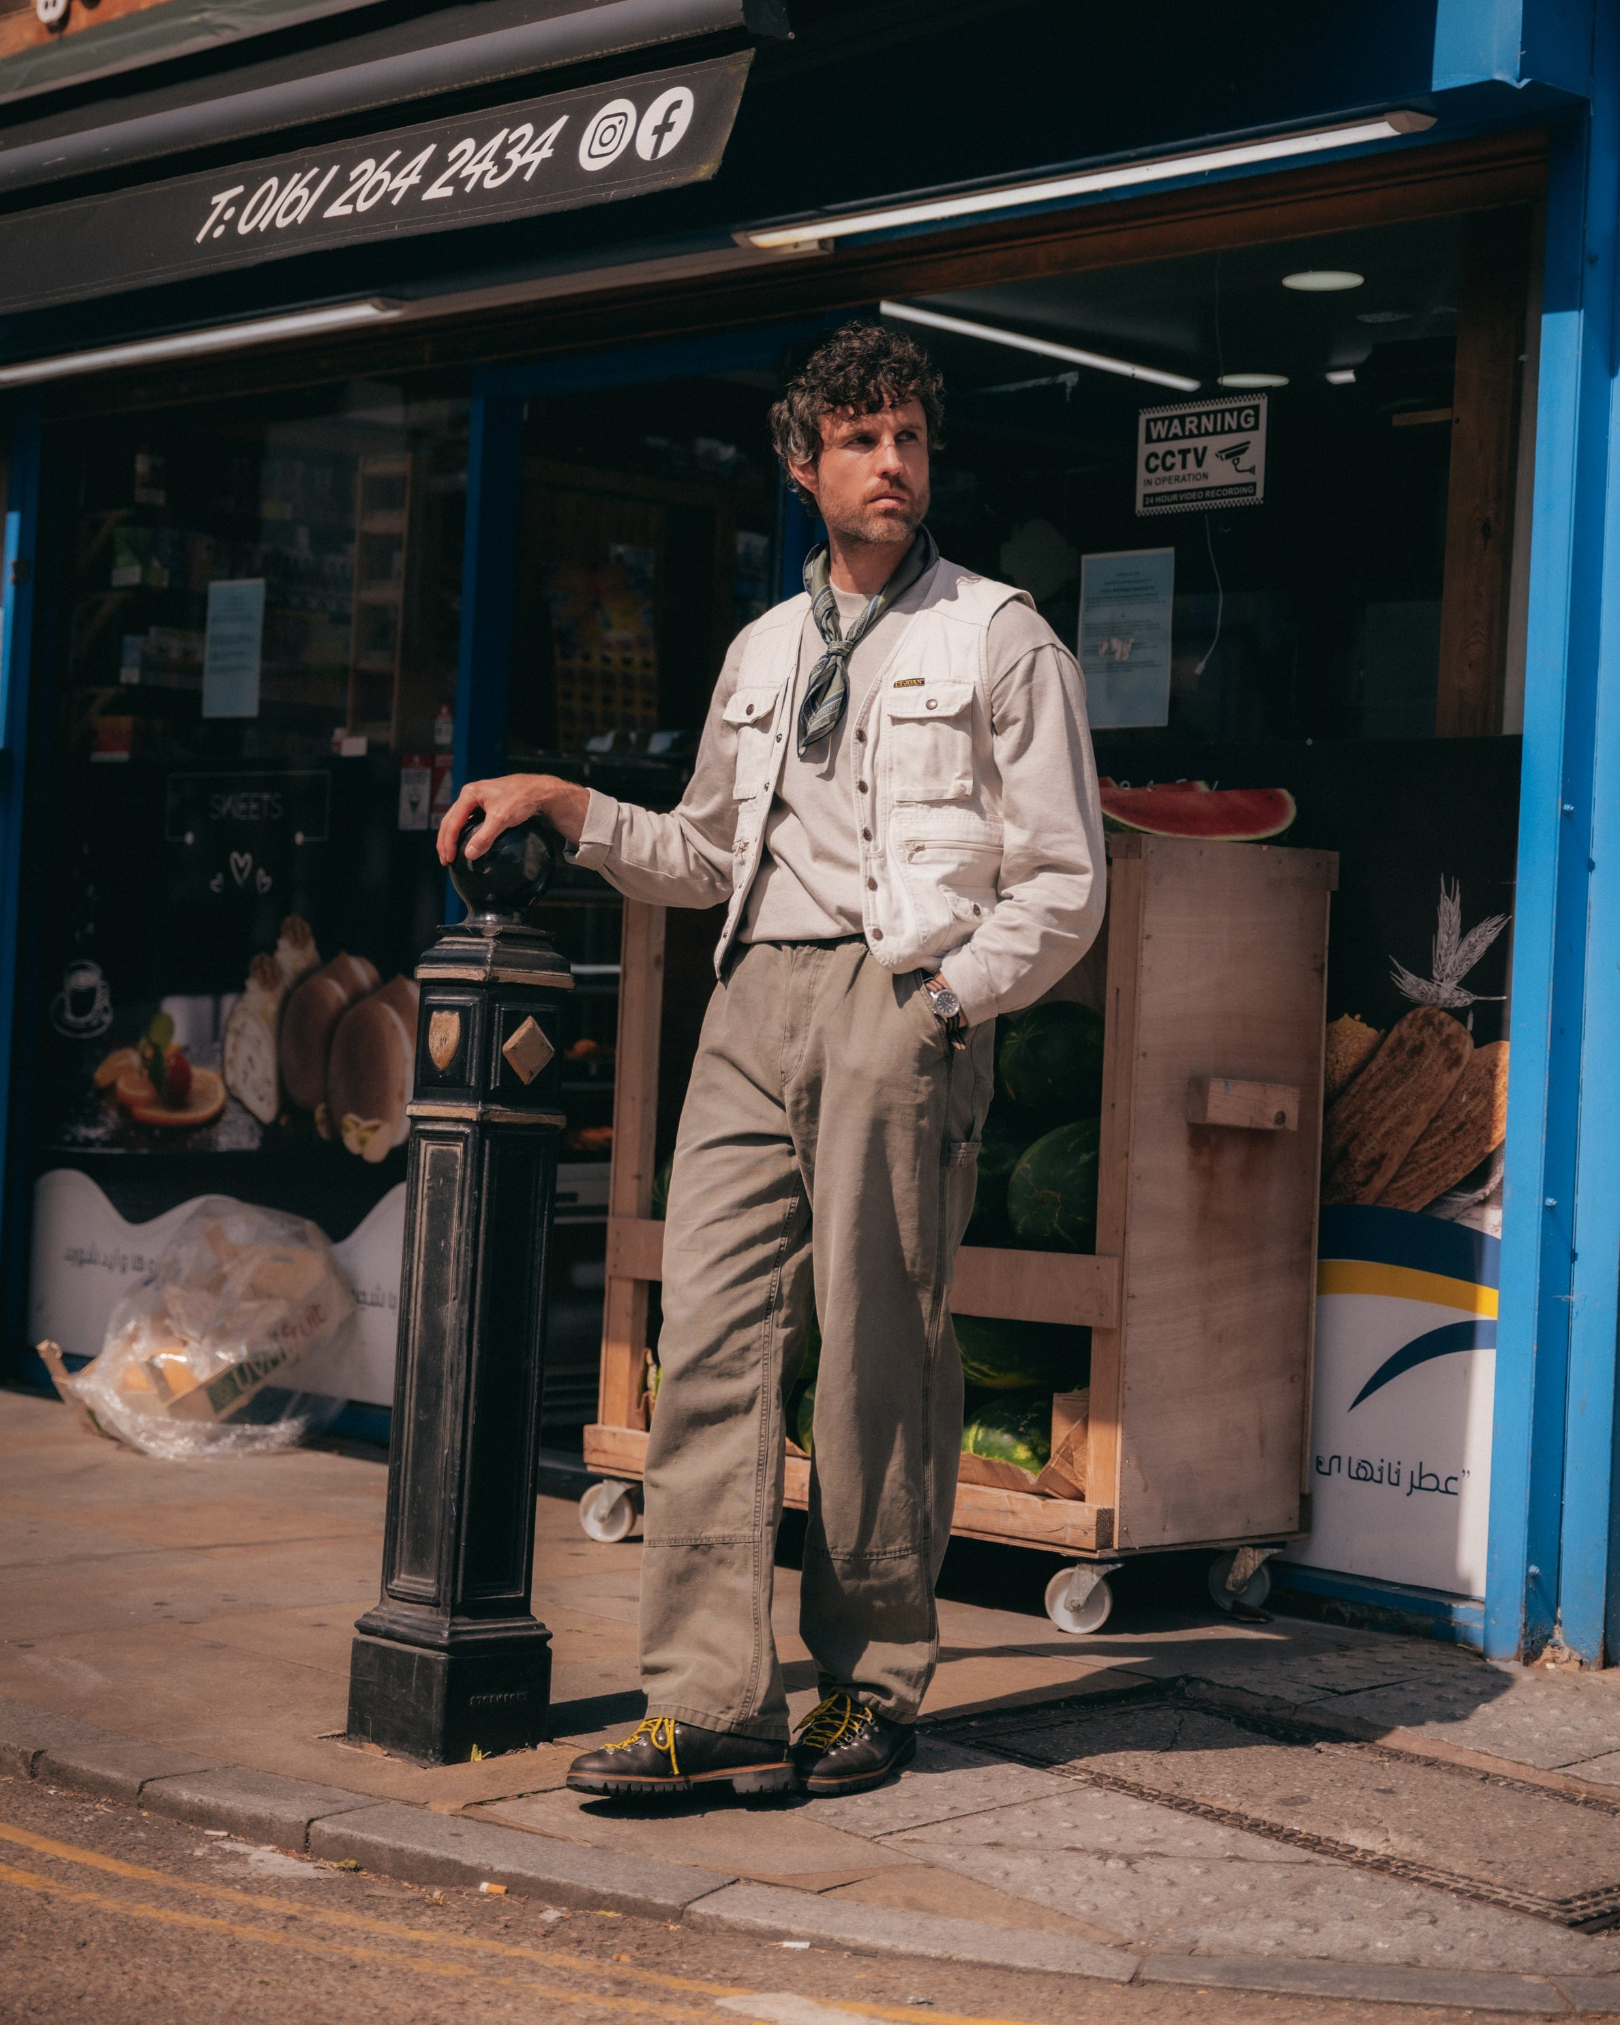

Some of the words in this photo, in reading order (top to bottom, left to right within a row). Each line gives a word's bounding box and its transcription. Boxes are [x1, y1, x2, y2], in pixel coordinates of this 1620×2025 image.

[323, 143, 437, 219] 264
[421, 115, 570, 202] 2434
[1149, 408, 1255, 440] WARNING
[1144, 446, 1208, 474] CCTV
[1143, 478, 1153, 487] IN
[1154, 472, 1209, 486] OPERATION
[1145, 496, 1154, 505] 24
[1155, 493, 1179, 504] HOUR
[1179, 490, 1204, 501] VIDEO
[1205, 485, 1254, 498] RECORDING
[209, 791, 284, 820] SWEETS
